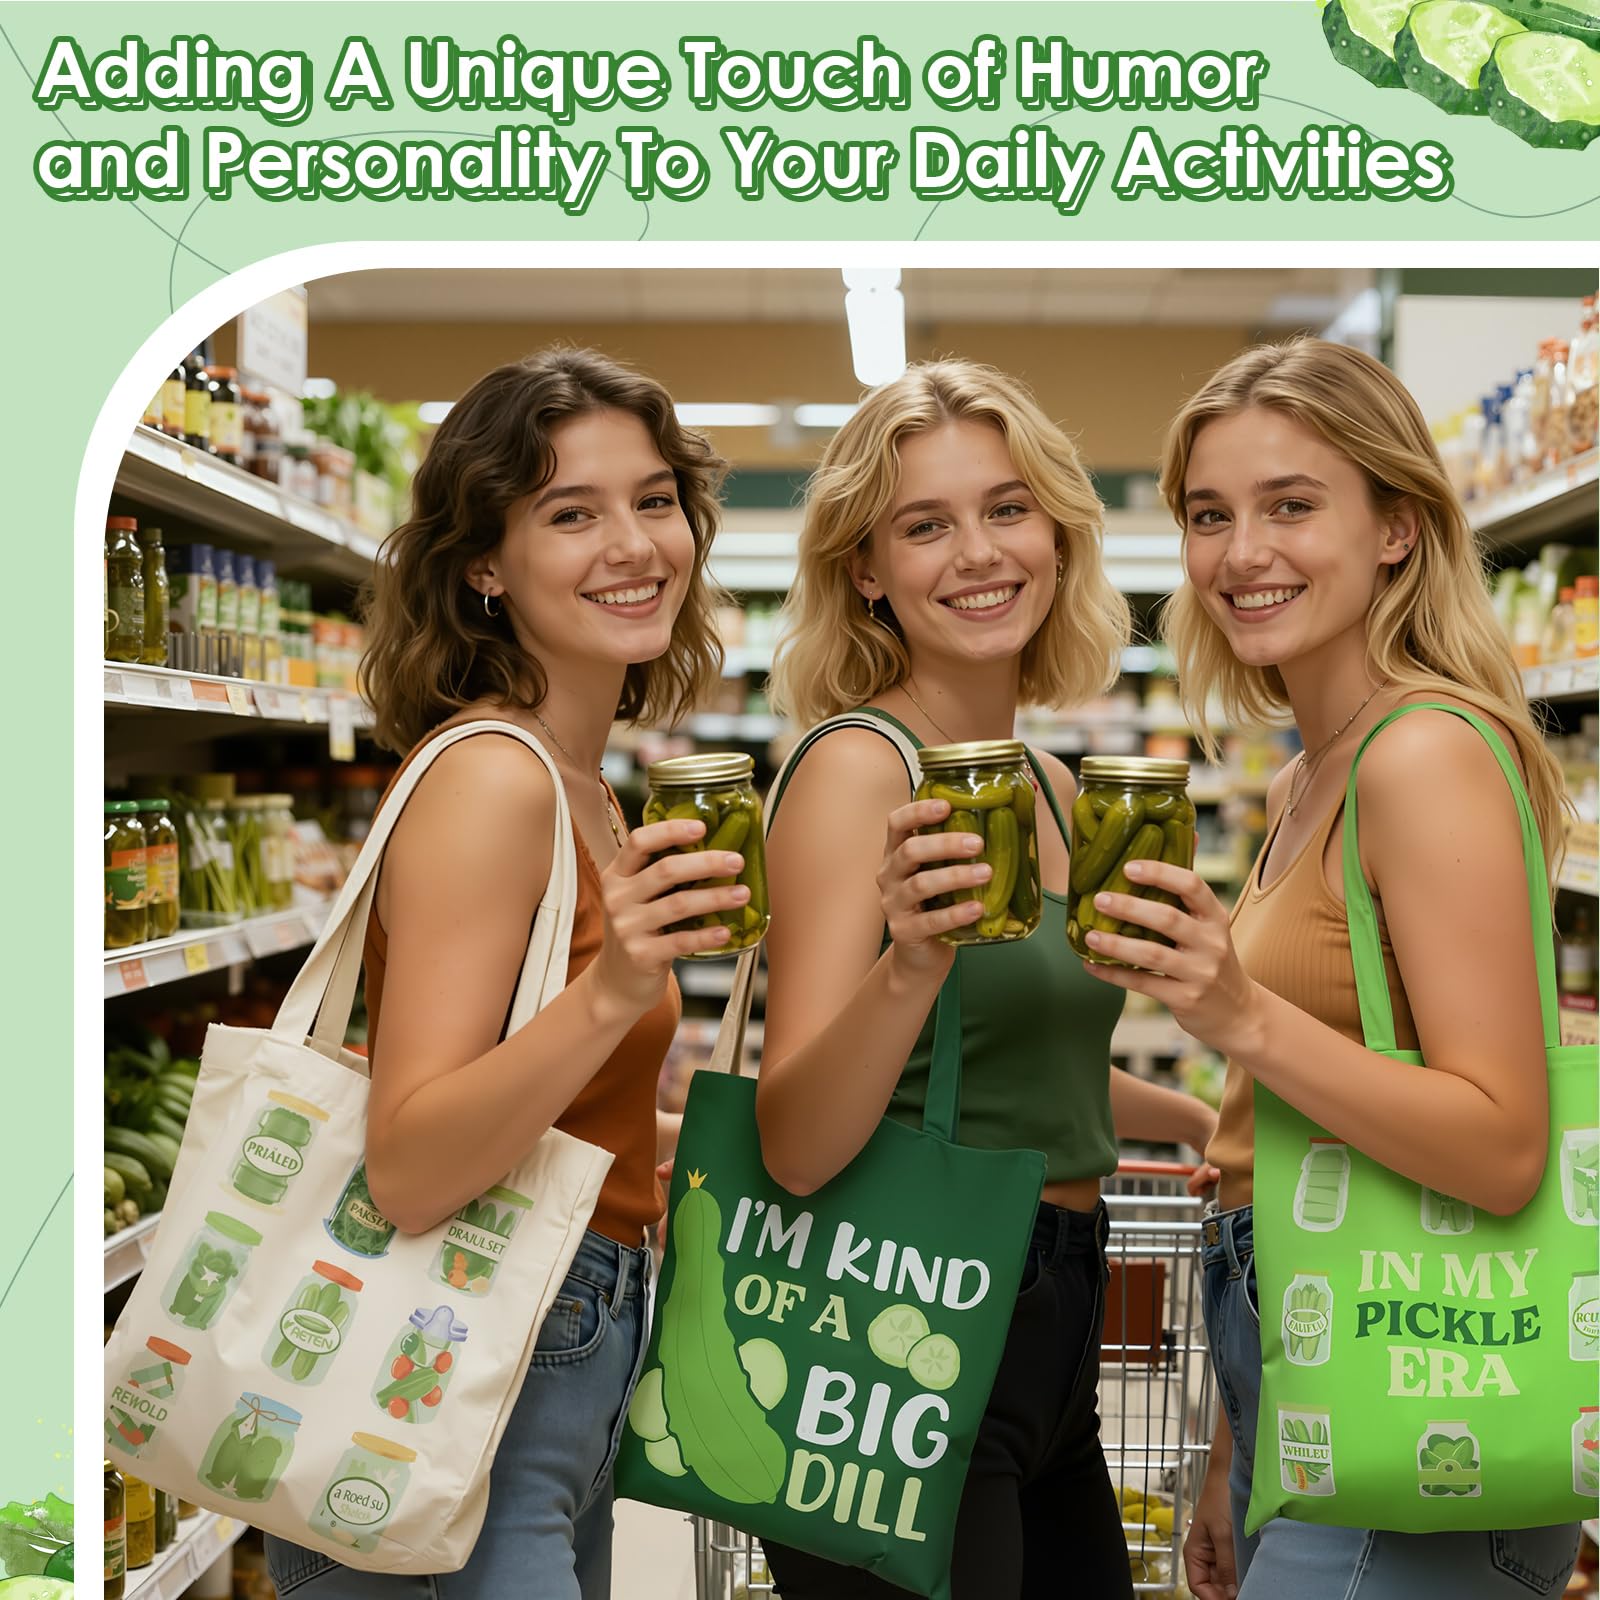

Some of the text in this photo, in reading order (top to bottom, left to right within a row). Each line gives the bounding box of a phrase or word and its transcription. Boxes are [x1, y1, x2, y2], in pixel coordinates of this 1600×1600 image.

[726, 1196, 991, 1311] I'M KIND
[1357, 1248, 1538, 1299] IN MY
[734, 1273, 851, 1342] OF A
[1355, 1300, 1541, 1346] PICKLE
[1387, 1345, 1520, 1398] ERA
[111, 1385, 168, 1421] REWOLD
[796, 1365, 951, 1469] BIG
[785, 1449, 928, 1542] DILL
